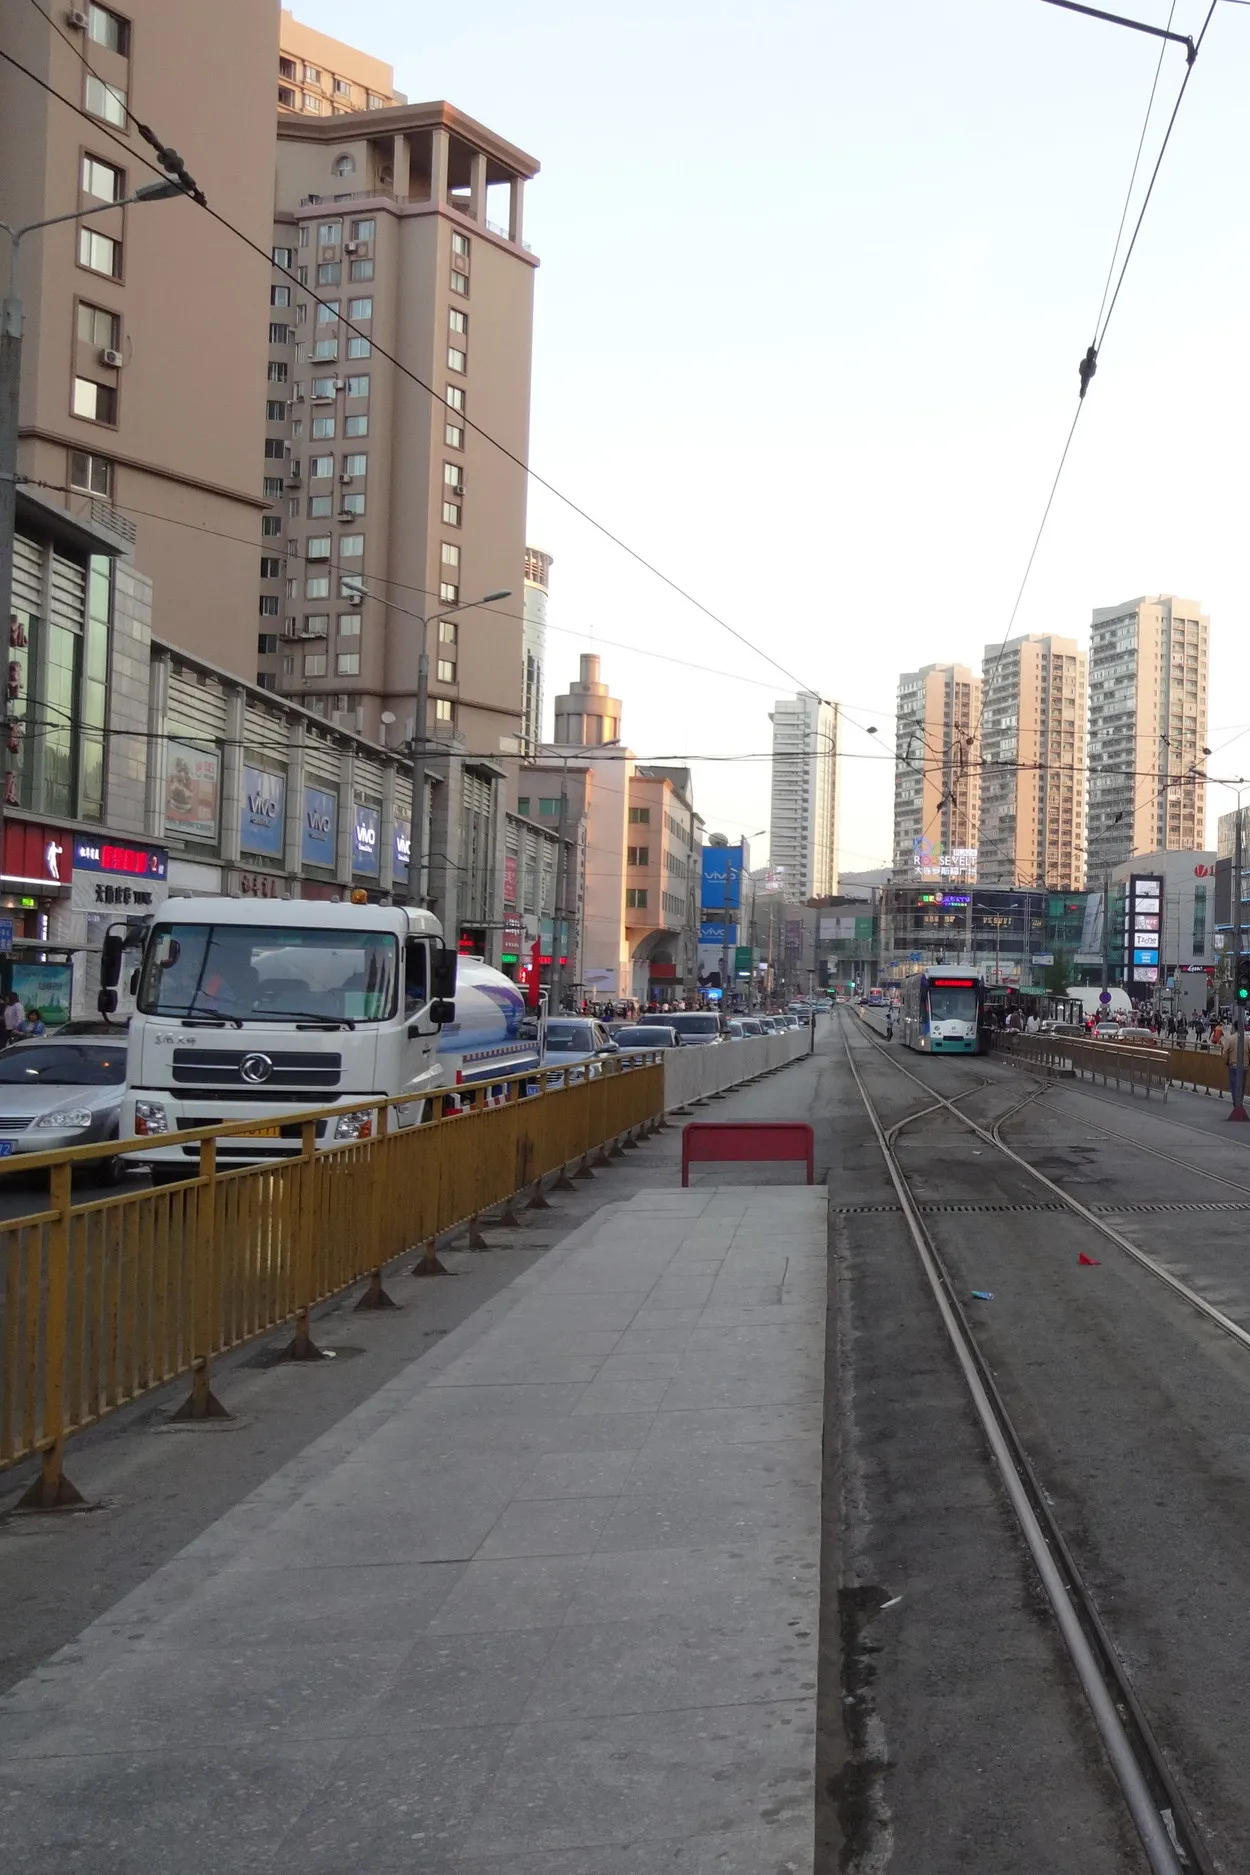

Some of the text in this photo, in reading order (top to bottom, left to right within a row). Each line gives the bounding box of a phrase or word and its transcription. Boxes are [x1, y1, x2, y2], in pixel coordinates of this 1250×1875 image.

[247, 790, 277, 818] vivo
[307, 809, 331, 833] vivo
[356, 822, 376, 845] vivo
